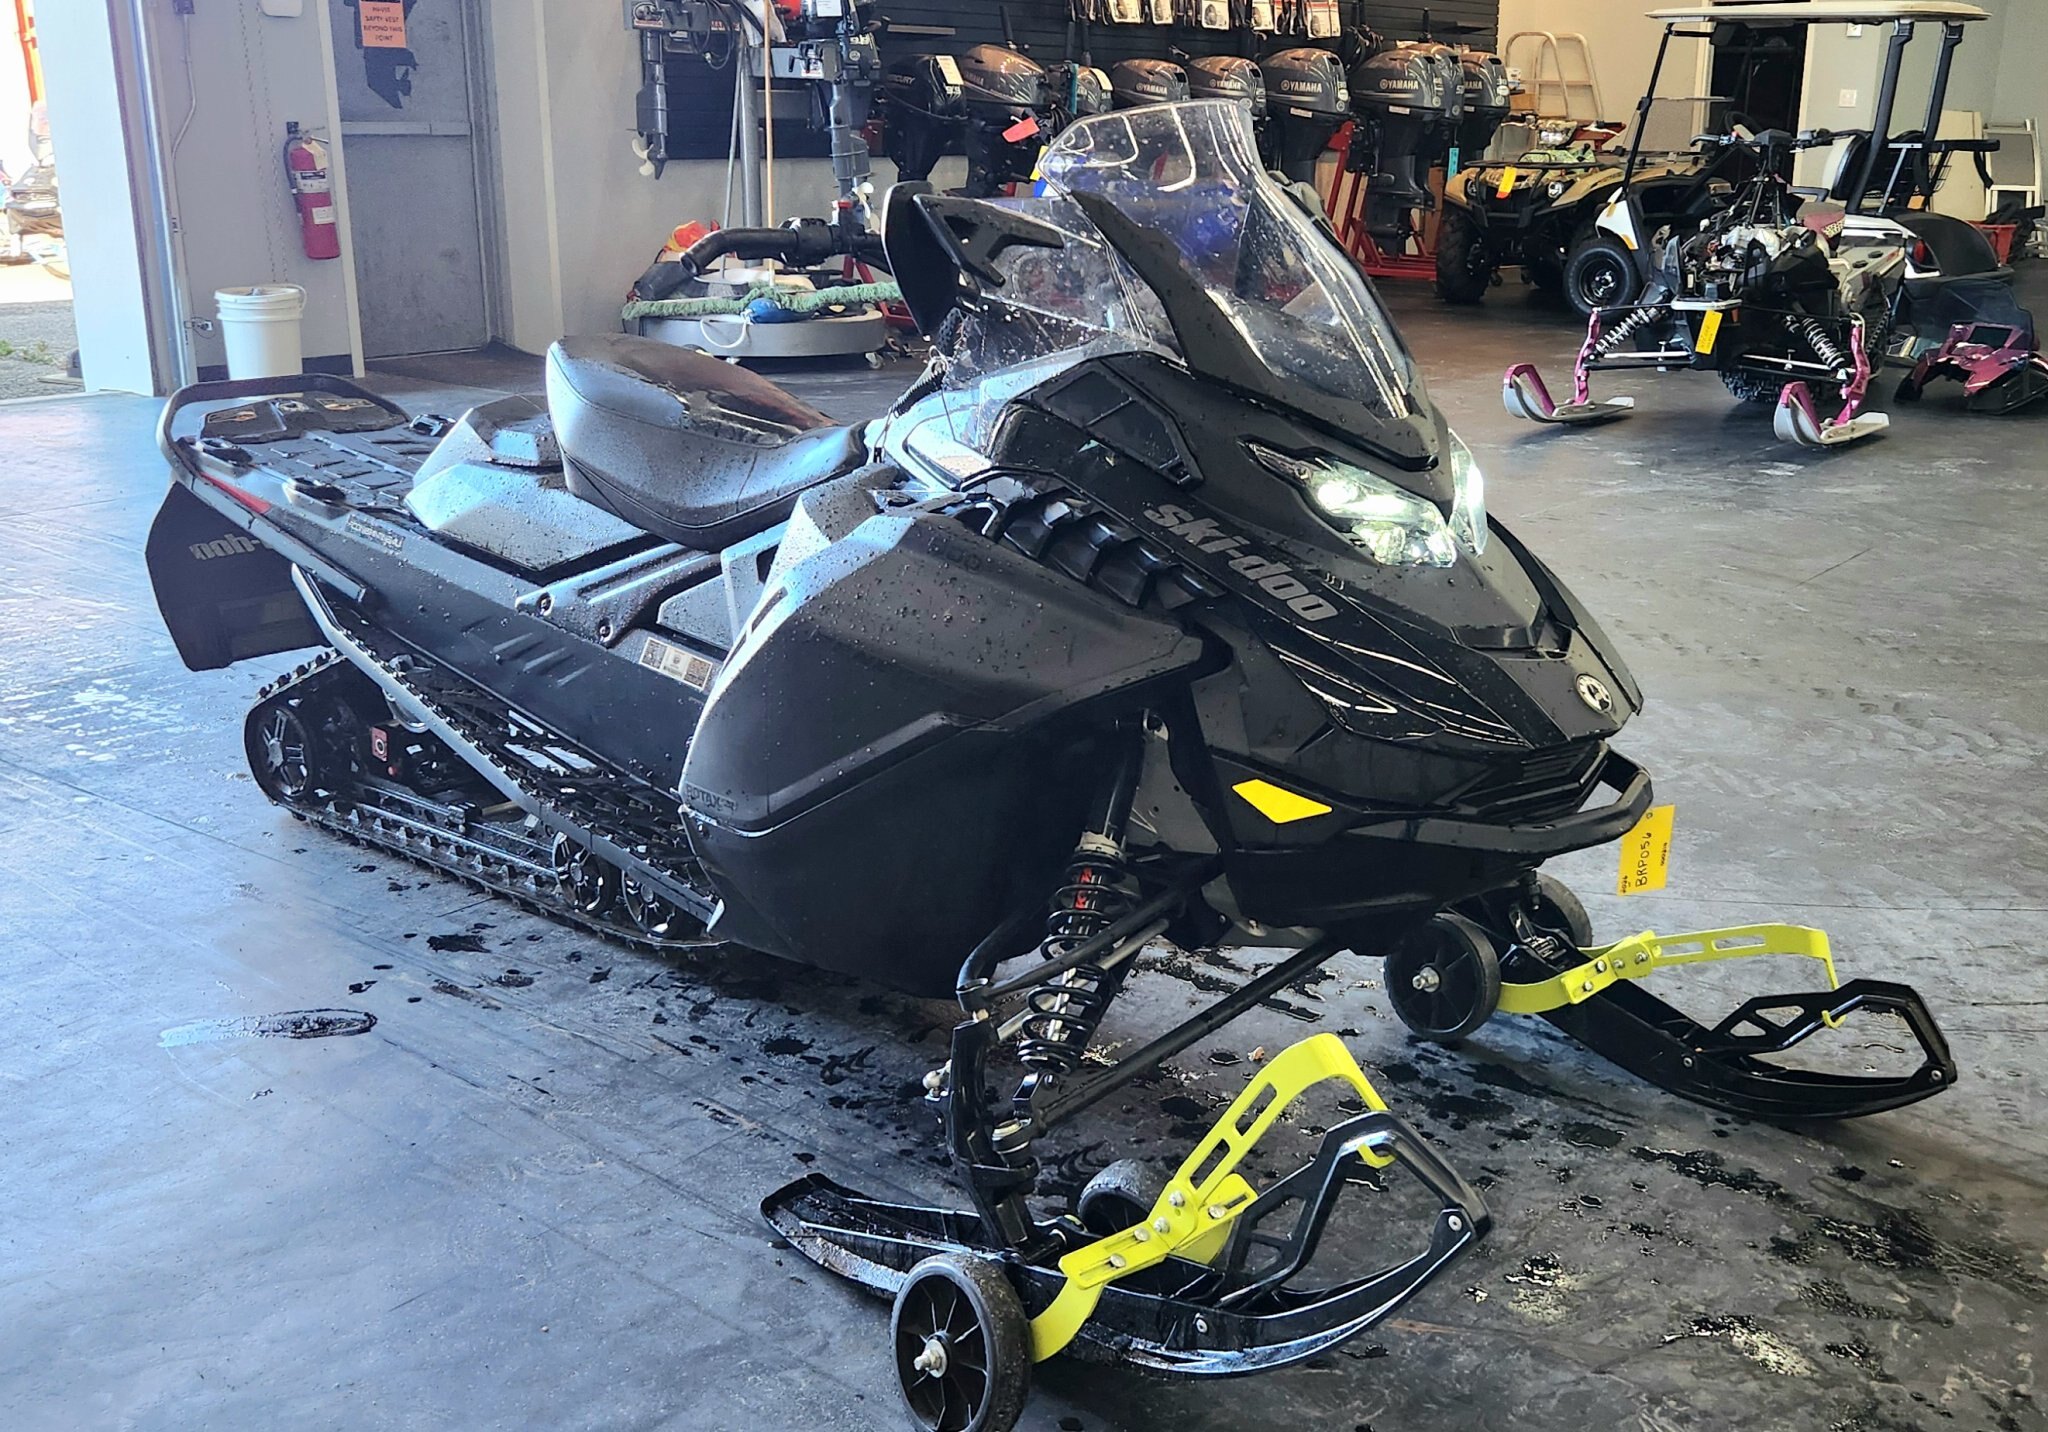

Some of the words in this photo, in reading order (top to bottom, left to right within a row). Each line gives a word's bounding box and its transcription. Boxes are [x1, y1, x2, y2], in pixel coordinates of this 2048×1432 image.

[1143, 83, 1168, 96] YAMAHA
[1216, 80, 1241, 90] YAMAHA
[1289, 81, 1323, 93] YAMAHA
[1388, 79, 1419, 90] YAMAHA
[1465, 80, 1483, 90] MAHA
[1634, 831, 1653, 888] BRP056
